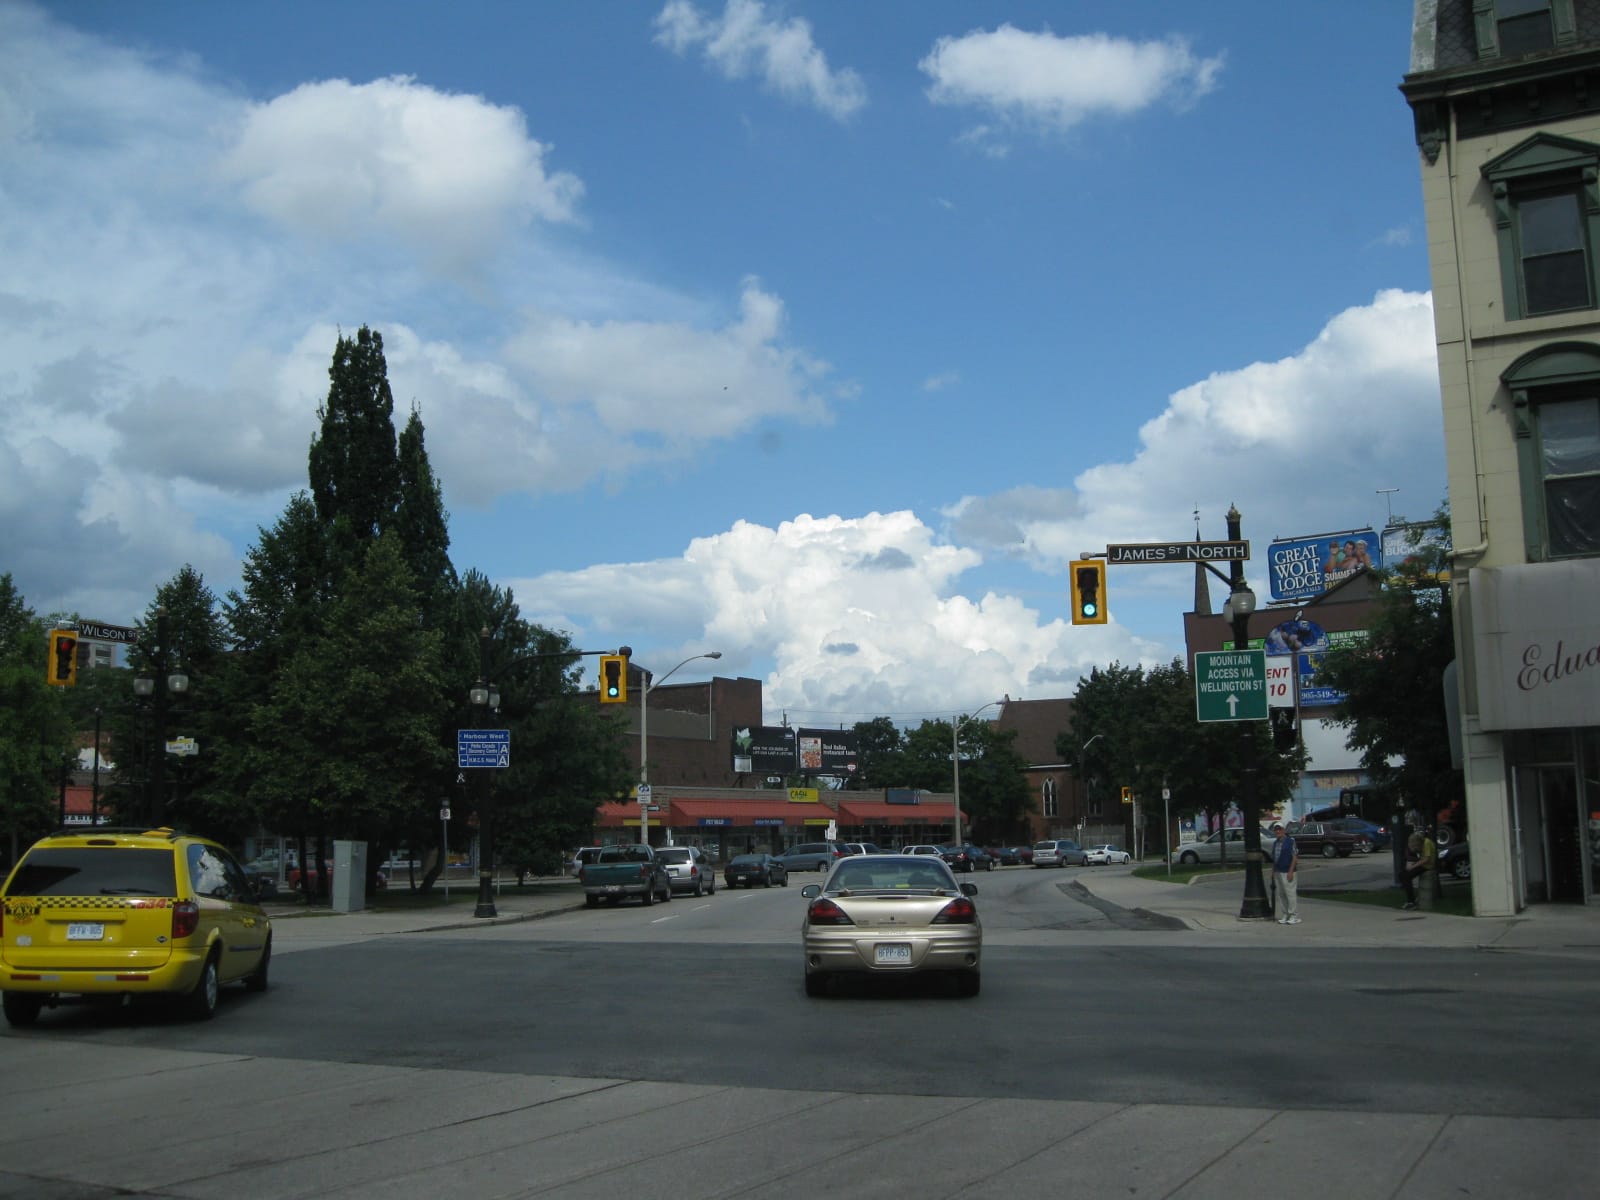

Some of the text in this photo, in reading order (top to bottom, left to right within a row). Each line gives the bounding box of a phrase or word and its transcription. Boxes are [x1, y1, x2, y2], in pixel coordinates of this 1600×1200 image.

[1112, 547, 1166, 561] JAMES
[1186, 545, 1245, 559] NORTH
[1274, 544, 1318, 565] GREAT
[1275, 558, 1321, 579] WOLF
[1278, 573, 1323, 592] LODGE
[81, 623, 126, 640] WILSON
[1209, 655, 1252, 667] MOUNTAIN
[1207, 667, 1255, 680] ACCESS VIA
[1200, 679, 1264, 693] WELLINGTON ST
[500, 744, 509, 754] A
[498, 755, 507, 766] A
[790, 790, 807, 799] CASH
